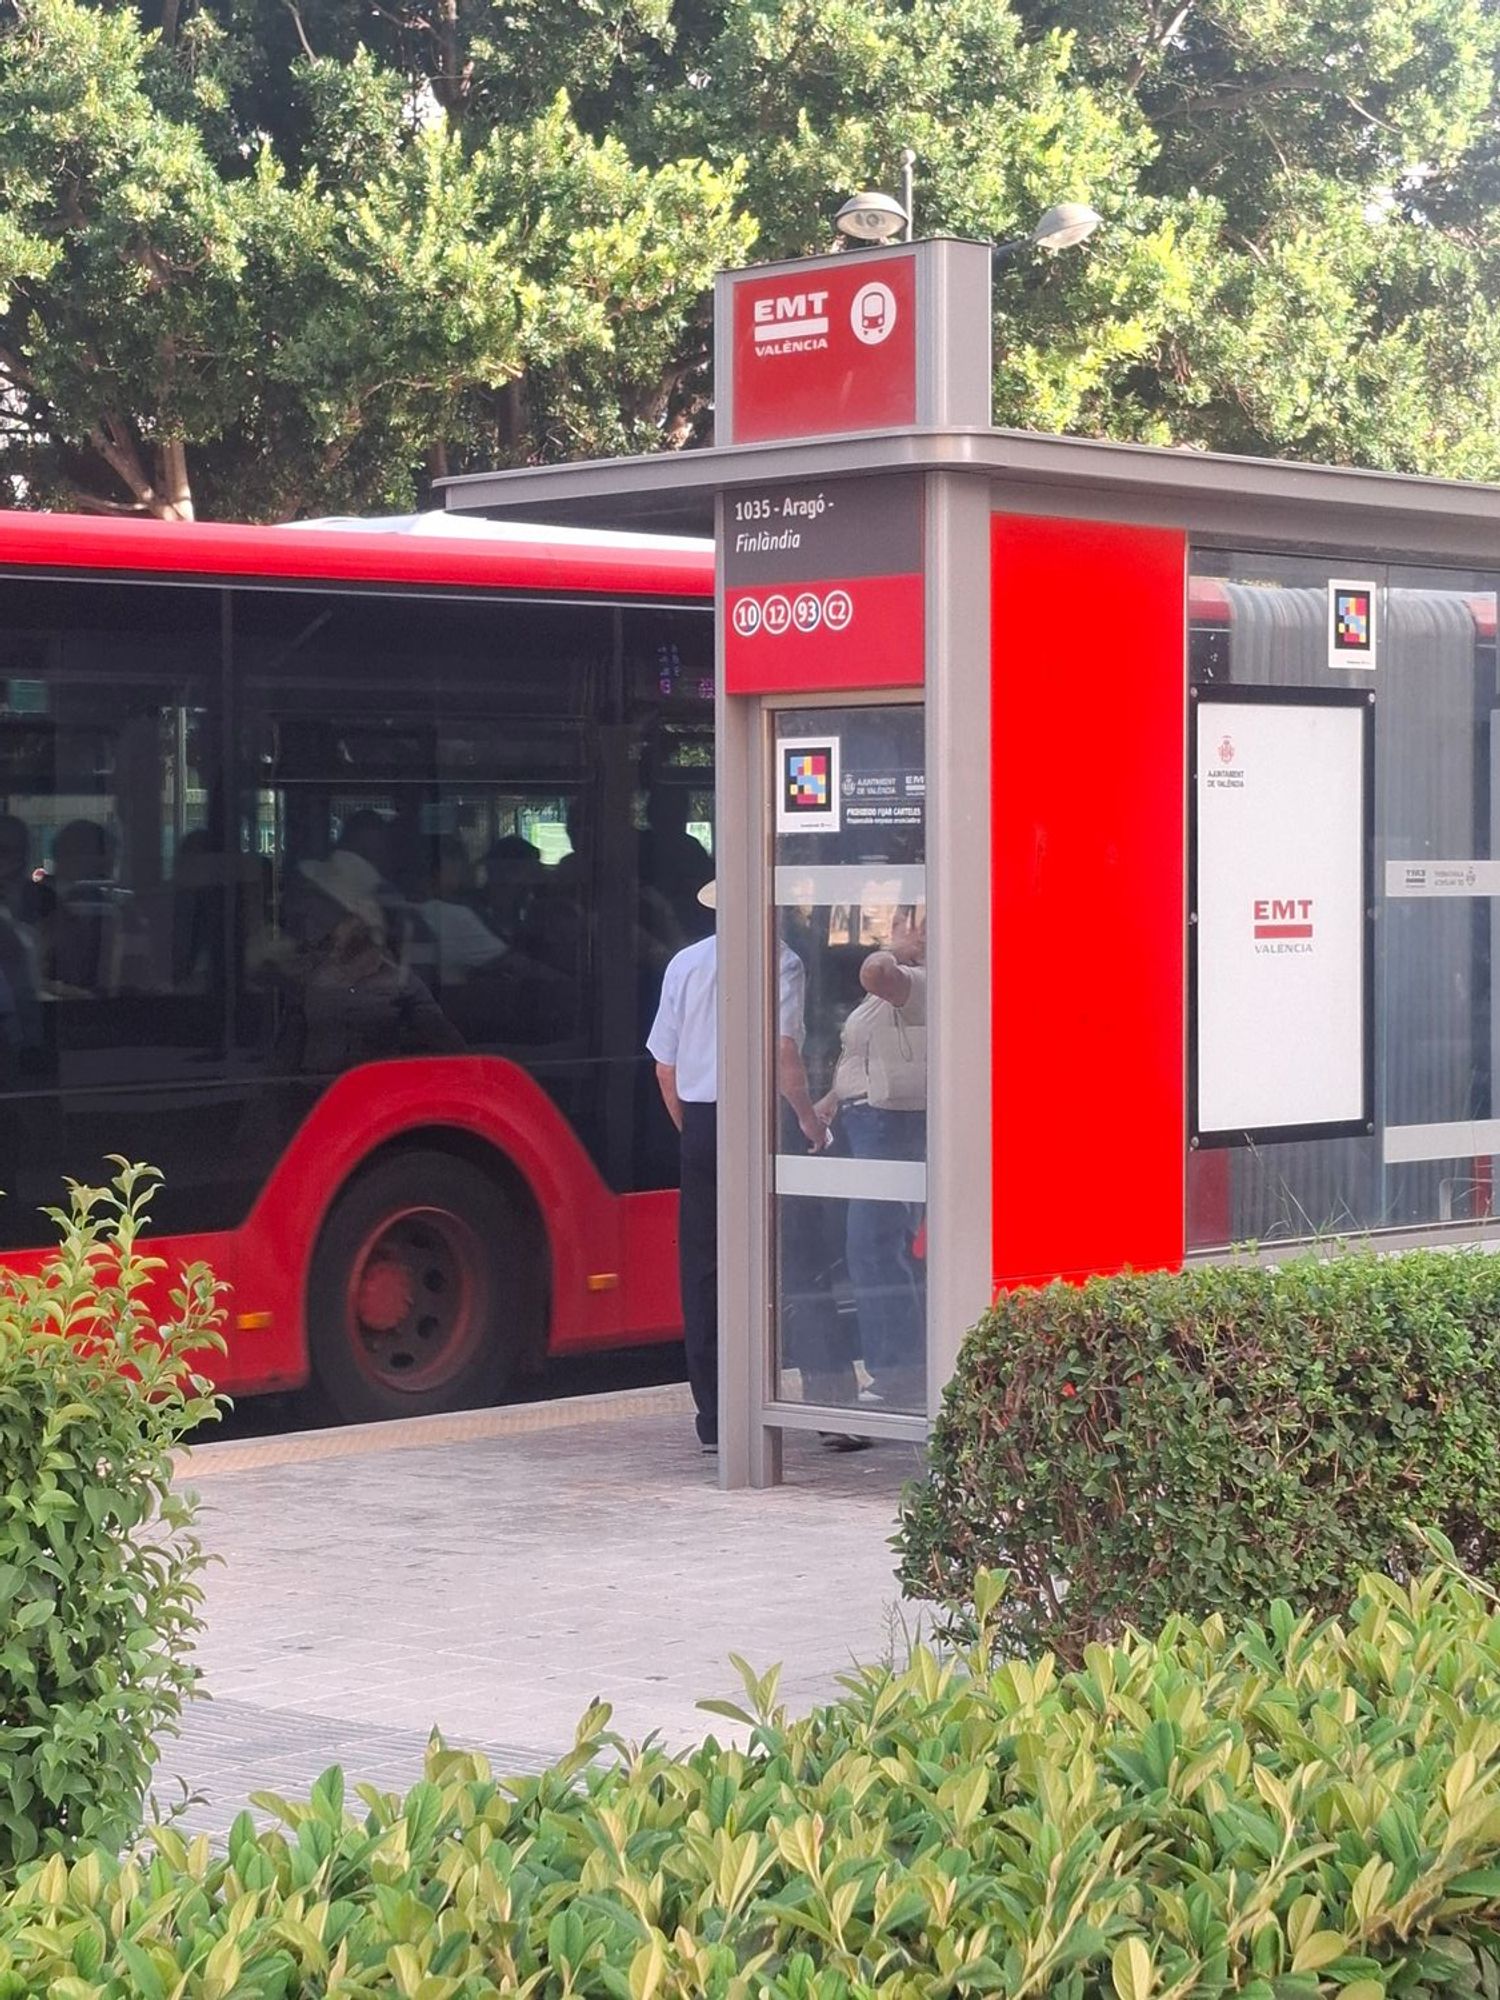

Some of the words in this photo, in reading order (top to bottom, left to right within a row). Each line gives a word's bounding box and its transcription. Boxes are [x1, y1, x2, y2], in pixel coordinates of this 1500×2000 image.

[754, 291, 829, 322] EMT
[755, 338, 829, 357] VALÈNCIA
[735, 500, 770, 520] 1035
[782, 493, 825, 520] Aragó
[736, 529, 801, 552] Finlàndia
[738, 605, 757, 627] 10
[769, 605, 785, 624] 12
[797, 601, 817, 622] 93
[828, 601, 846, 620] C2
[905, 776, 924, 784] EM
[1254, 900, 1313, 920] EMT
